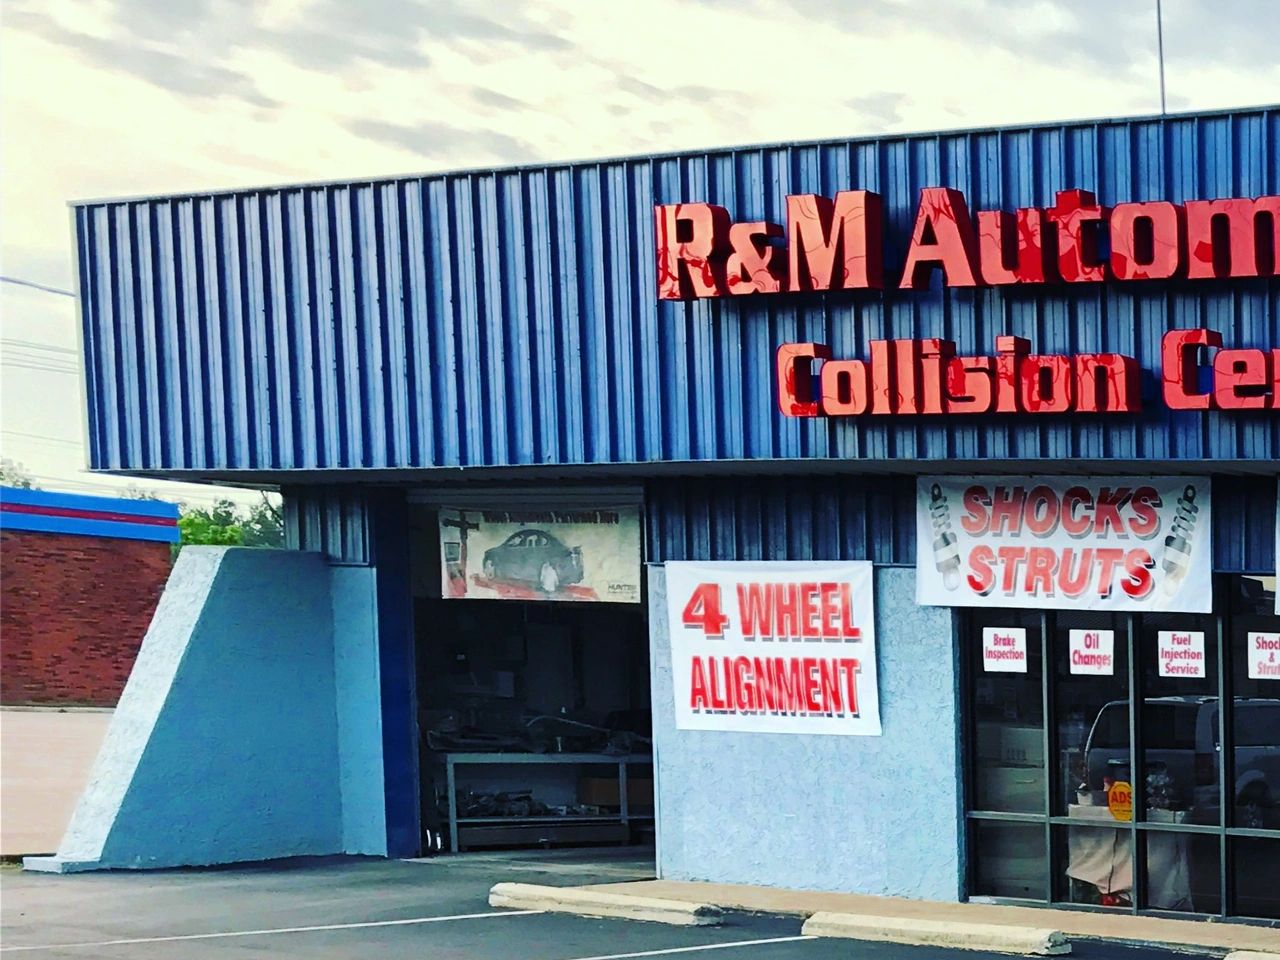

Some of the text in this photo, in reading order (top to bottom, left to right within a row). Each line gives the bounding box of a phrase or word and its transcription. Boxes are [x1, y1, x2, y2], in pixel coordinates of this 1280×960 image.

[655, 188, 884, 299] R&M
[777, 335, 1142, 417] Collision
[961, 485, 1162, 540] SHOCKS
[967, 544, 1156, 600] STRUTS
[682, 582, 862, 643] 4 WHEEL
[993, 633, 1016, 646] Brake
[1084, 633, 1100, 649] Oil
[1171, 633, 1192, 646] Fuel
[1268, 652, 1275, 662] &
[1072, 650, 1112, 669] Changes
[1165, 662, 1199, 675] Service
[690, 655, 862, 718] ALIGNMENT
